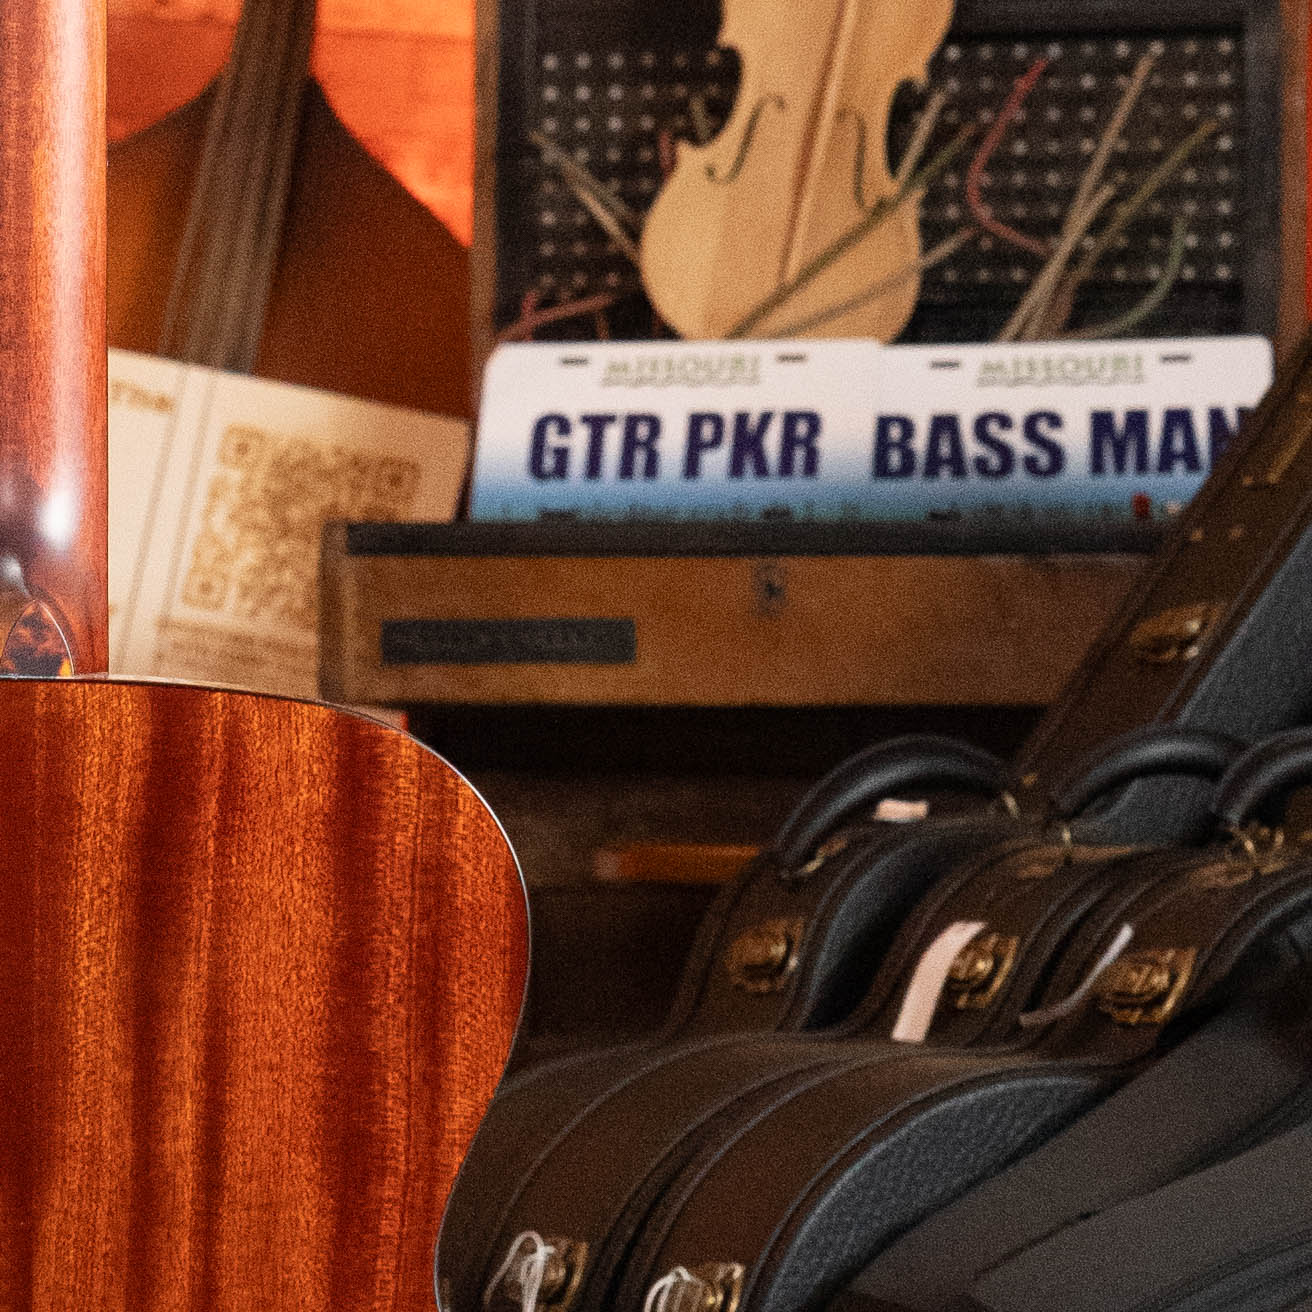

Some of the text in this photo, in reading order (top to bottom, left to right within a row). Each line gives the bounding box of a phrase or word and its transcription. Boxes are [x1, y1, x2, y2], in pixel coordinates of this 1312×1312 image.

[607, 353, 762, 382] MISSOURI
[980, 352, 1145, 384] MISSOURI
[530, 409, 822, 481] GTR PKR
[873, 409, 1068, 480] BASS
